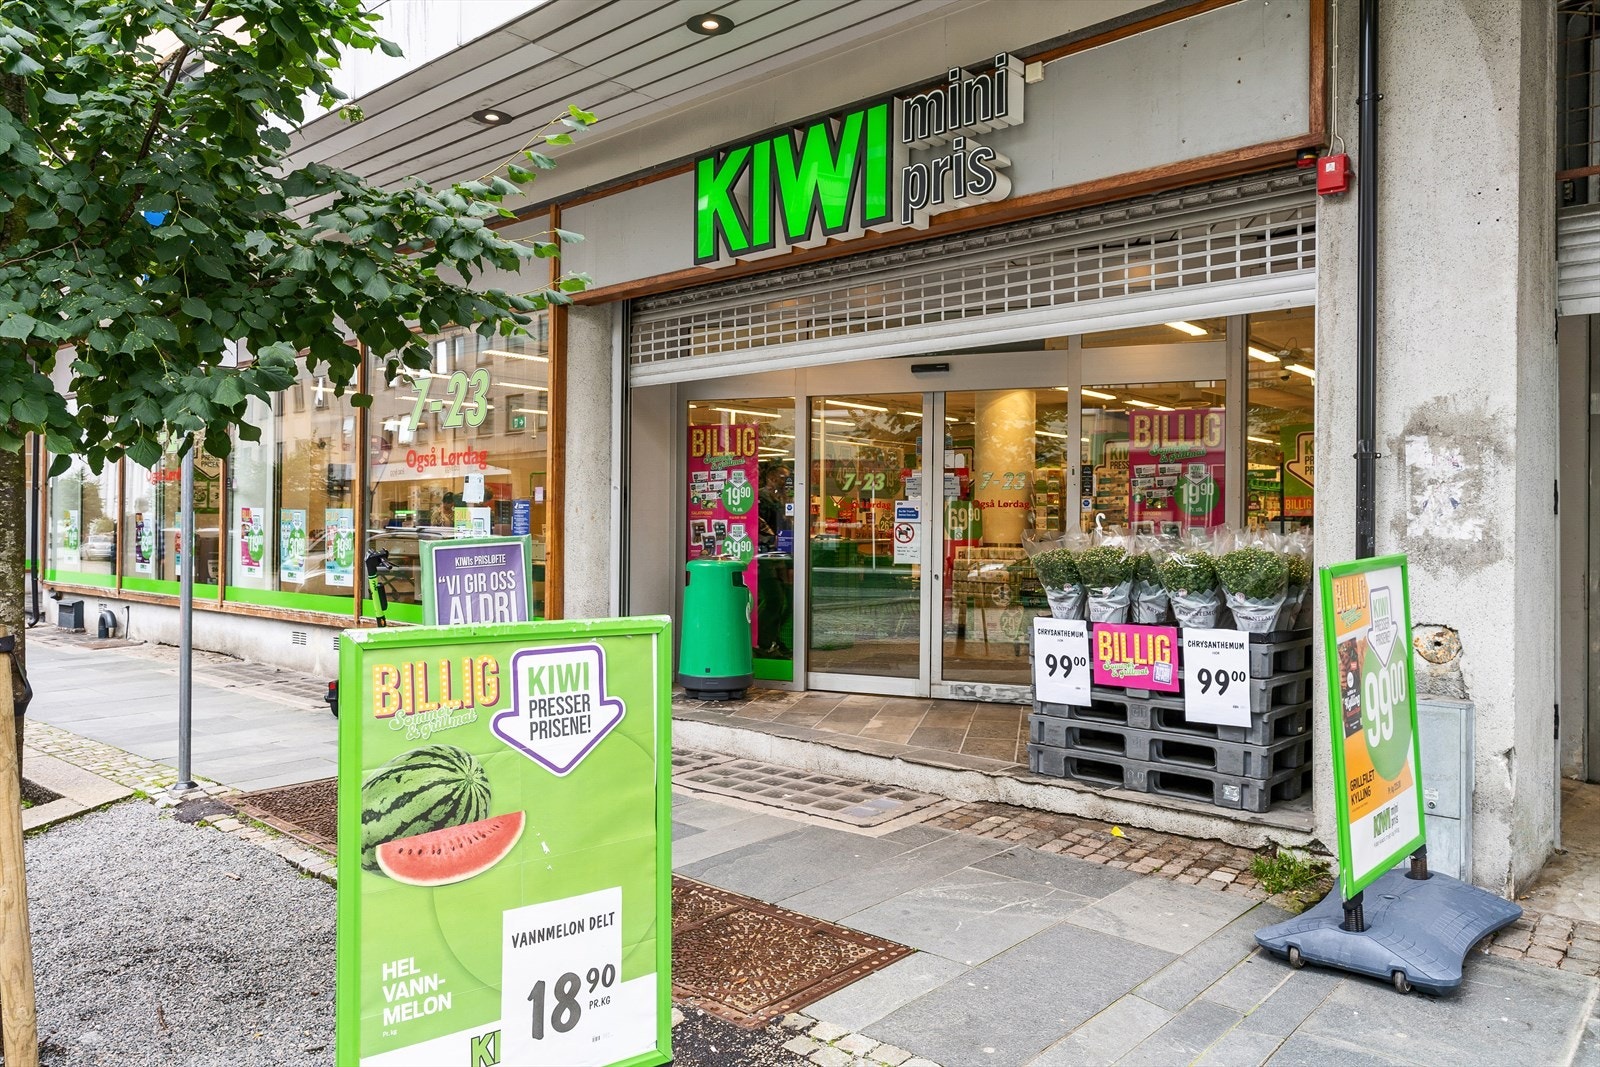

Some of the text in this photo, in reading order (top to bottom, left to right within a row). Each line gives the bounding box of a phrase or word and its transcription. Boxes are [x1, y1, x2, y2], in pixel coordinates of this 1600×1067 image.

[902, 51, 1008, 143] mini
[693, 98, 893, 266] KIWI
[901, 136, 997, 225] pris
[407, 367, 490, 432] 7-23
[691, 428, 756, 457] BILLIG
[1133, 413, 1221, 448] BILLIG
[406, 445, 488, 473] Også Lørdag
[841, 472, 886, 491] 7-23
[978, 471, 1027, 491] 7-23
[998, 499, 1031, 511] Lørdag
[1286, 499, 1312, 510] BILLIG
[454, 553, 506, 568] KIWIs PRISLØFTE
[464, 573, 487, 595] GIR
[490, 570, 516, 591] OSS
[1335, 576, 1367, 614] BILLIG
[1373, 596, 1390, 618] KIWI
[1037, 628, 1084, 638] CHRYSANTHEMUM
[1187, 639, 1245, 650] CHRYSANTHEMUM
[1098, 630, 1171, 666] BILLIG
[371, 654, 500, 719] BILLIG
[527, 661, 590, 697] KIWI
[529, 693, 591, 719] PRESSER
[420, 707, 478, 740] grillmat
[529, 715, 592, 741] PRISENE!
[1350, 769, 1375, 792] GRILLFILET
[1351, 785, 1372, 806] KYLLING
[1373, 811, 1391, 839] KIWI
[511, 911, 615, 949] VANNMELON DELT
[382, 957, 420, 982] HEL
[382, 971, 446, 1003] VANN-
[383, 992, 452, 1026] MELON
[588, 996, 611, 1010] PR.KG
[470, 1029, 501, 1067] KI
